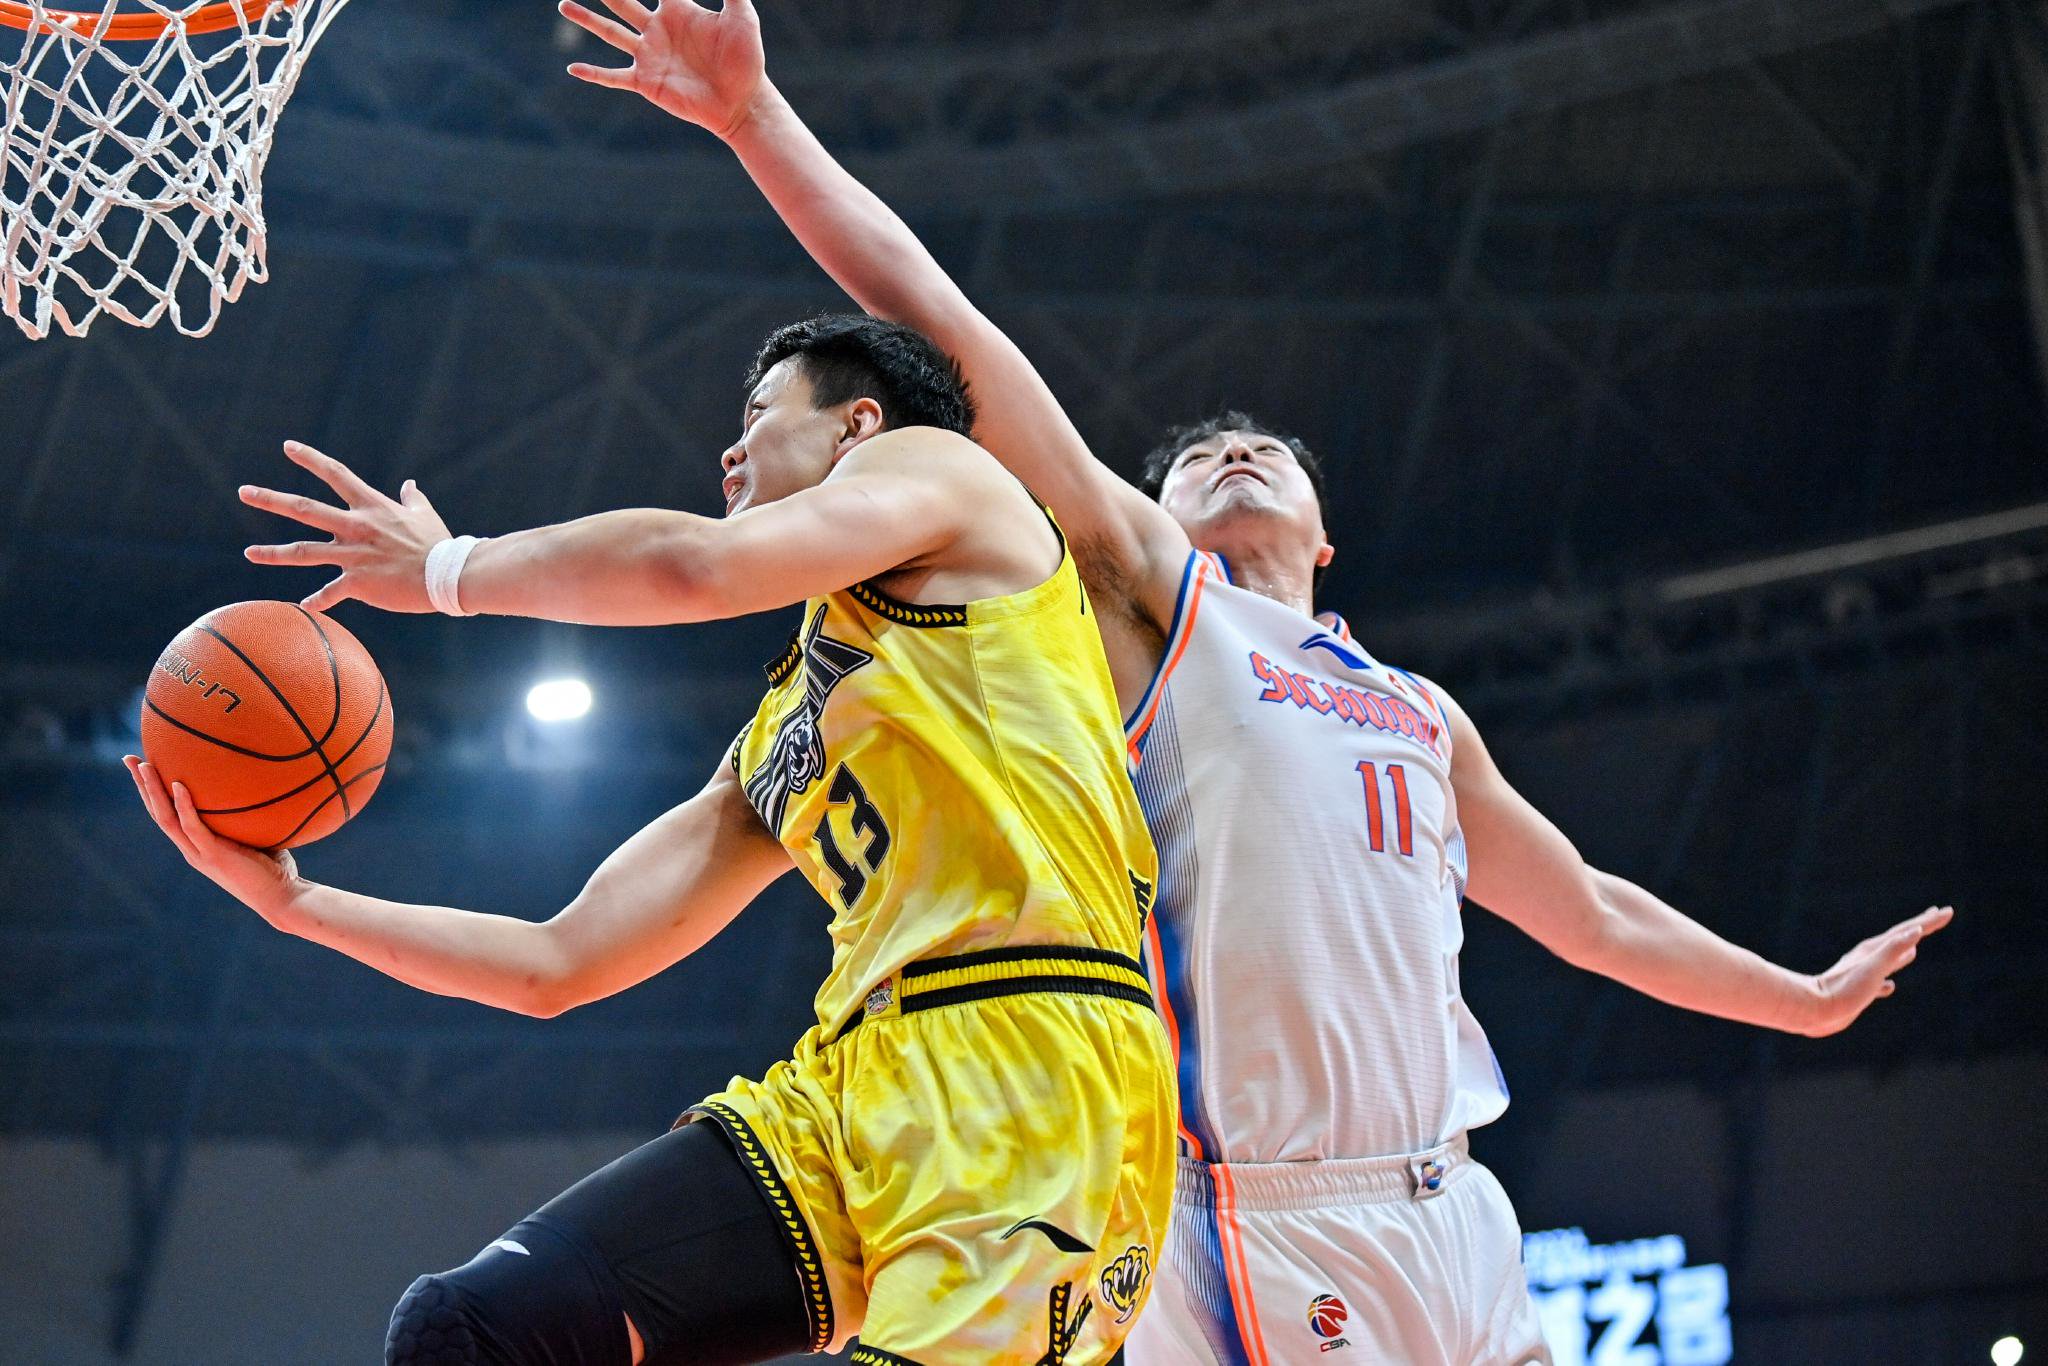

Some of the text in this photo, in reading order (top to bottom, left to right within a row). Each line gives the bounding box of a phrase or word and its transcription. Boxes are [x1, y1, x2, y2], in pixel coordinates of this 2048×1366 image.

[160, 653, 241, 714] LI-NIN
[812, 761, 891, 910] 13
[1355, 760, 1414, 857] 11
[1320, 1338, 1351, 1352] CBA
